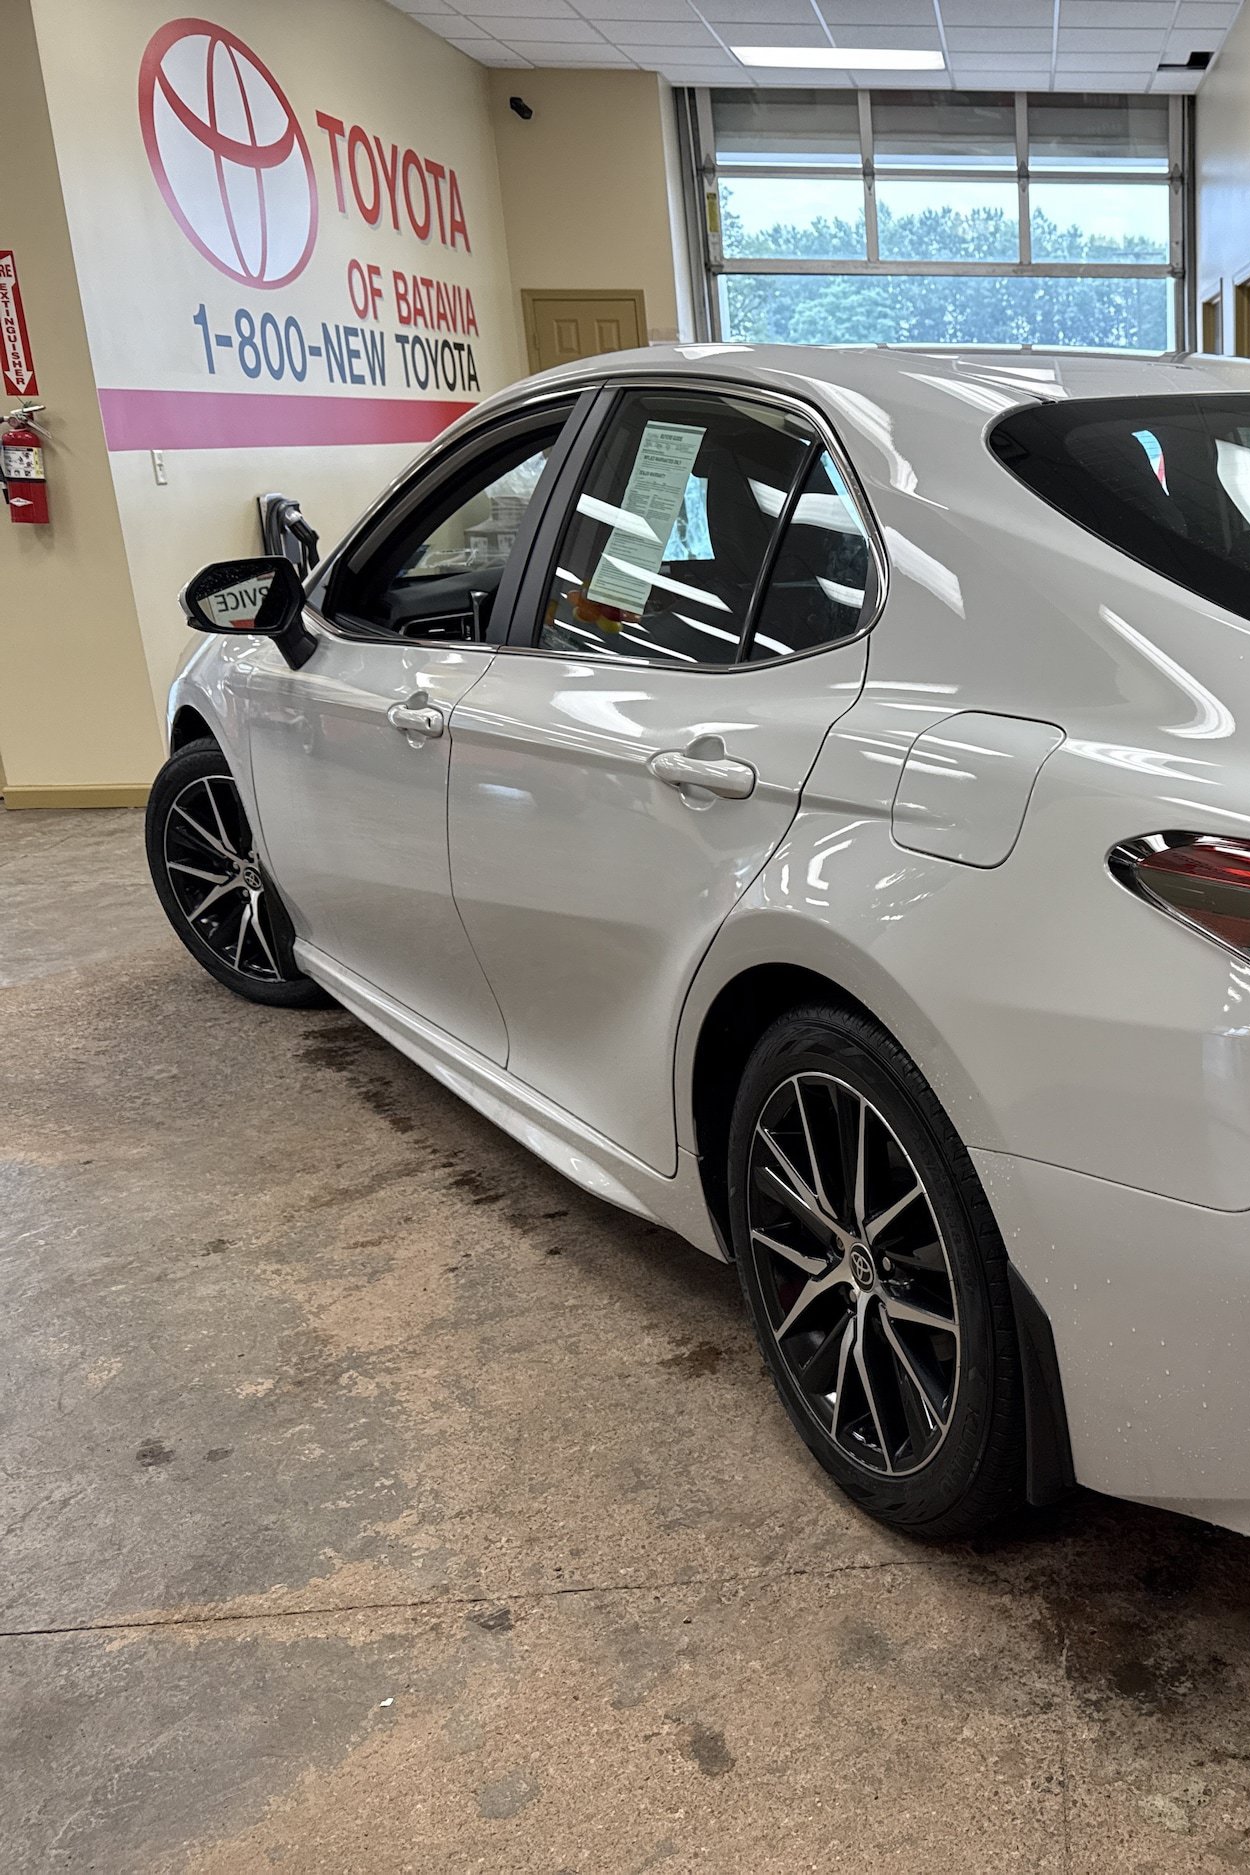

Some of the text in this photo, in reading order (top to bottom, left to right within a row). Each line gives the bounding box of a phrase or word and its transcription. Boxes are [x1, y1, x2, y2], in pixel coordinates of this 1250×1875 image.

[315, 110, 472, 253] TOYOTA
[0, 282, 26, 386] EXTINGUISHER
[348, 258, 480, 337] OF BATAVIA
[193, 303, 481, 393] 1-800-NEW TOYOTA
